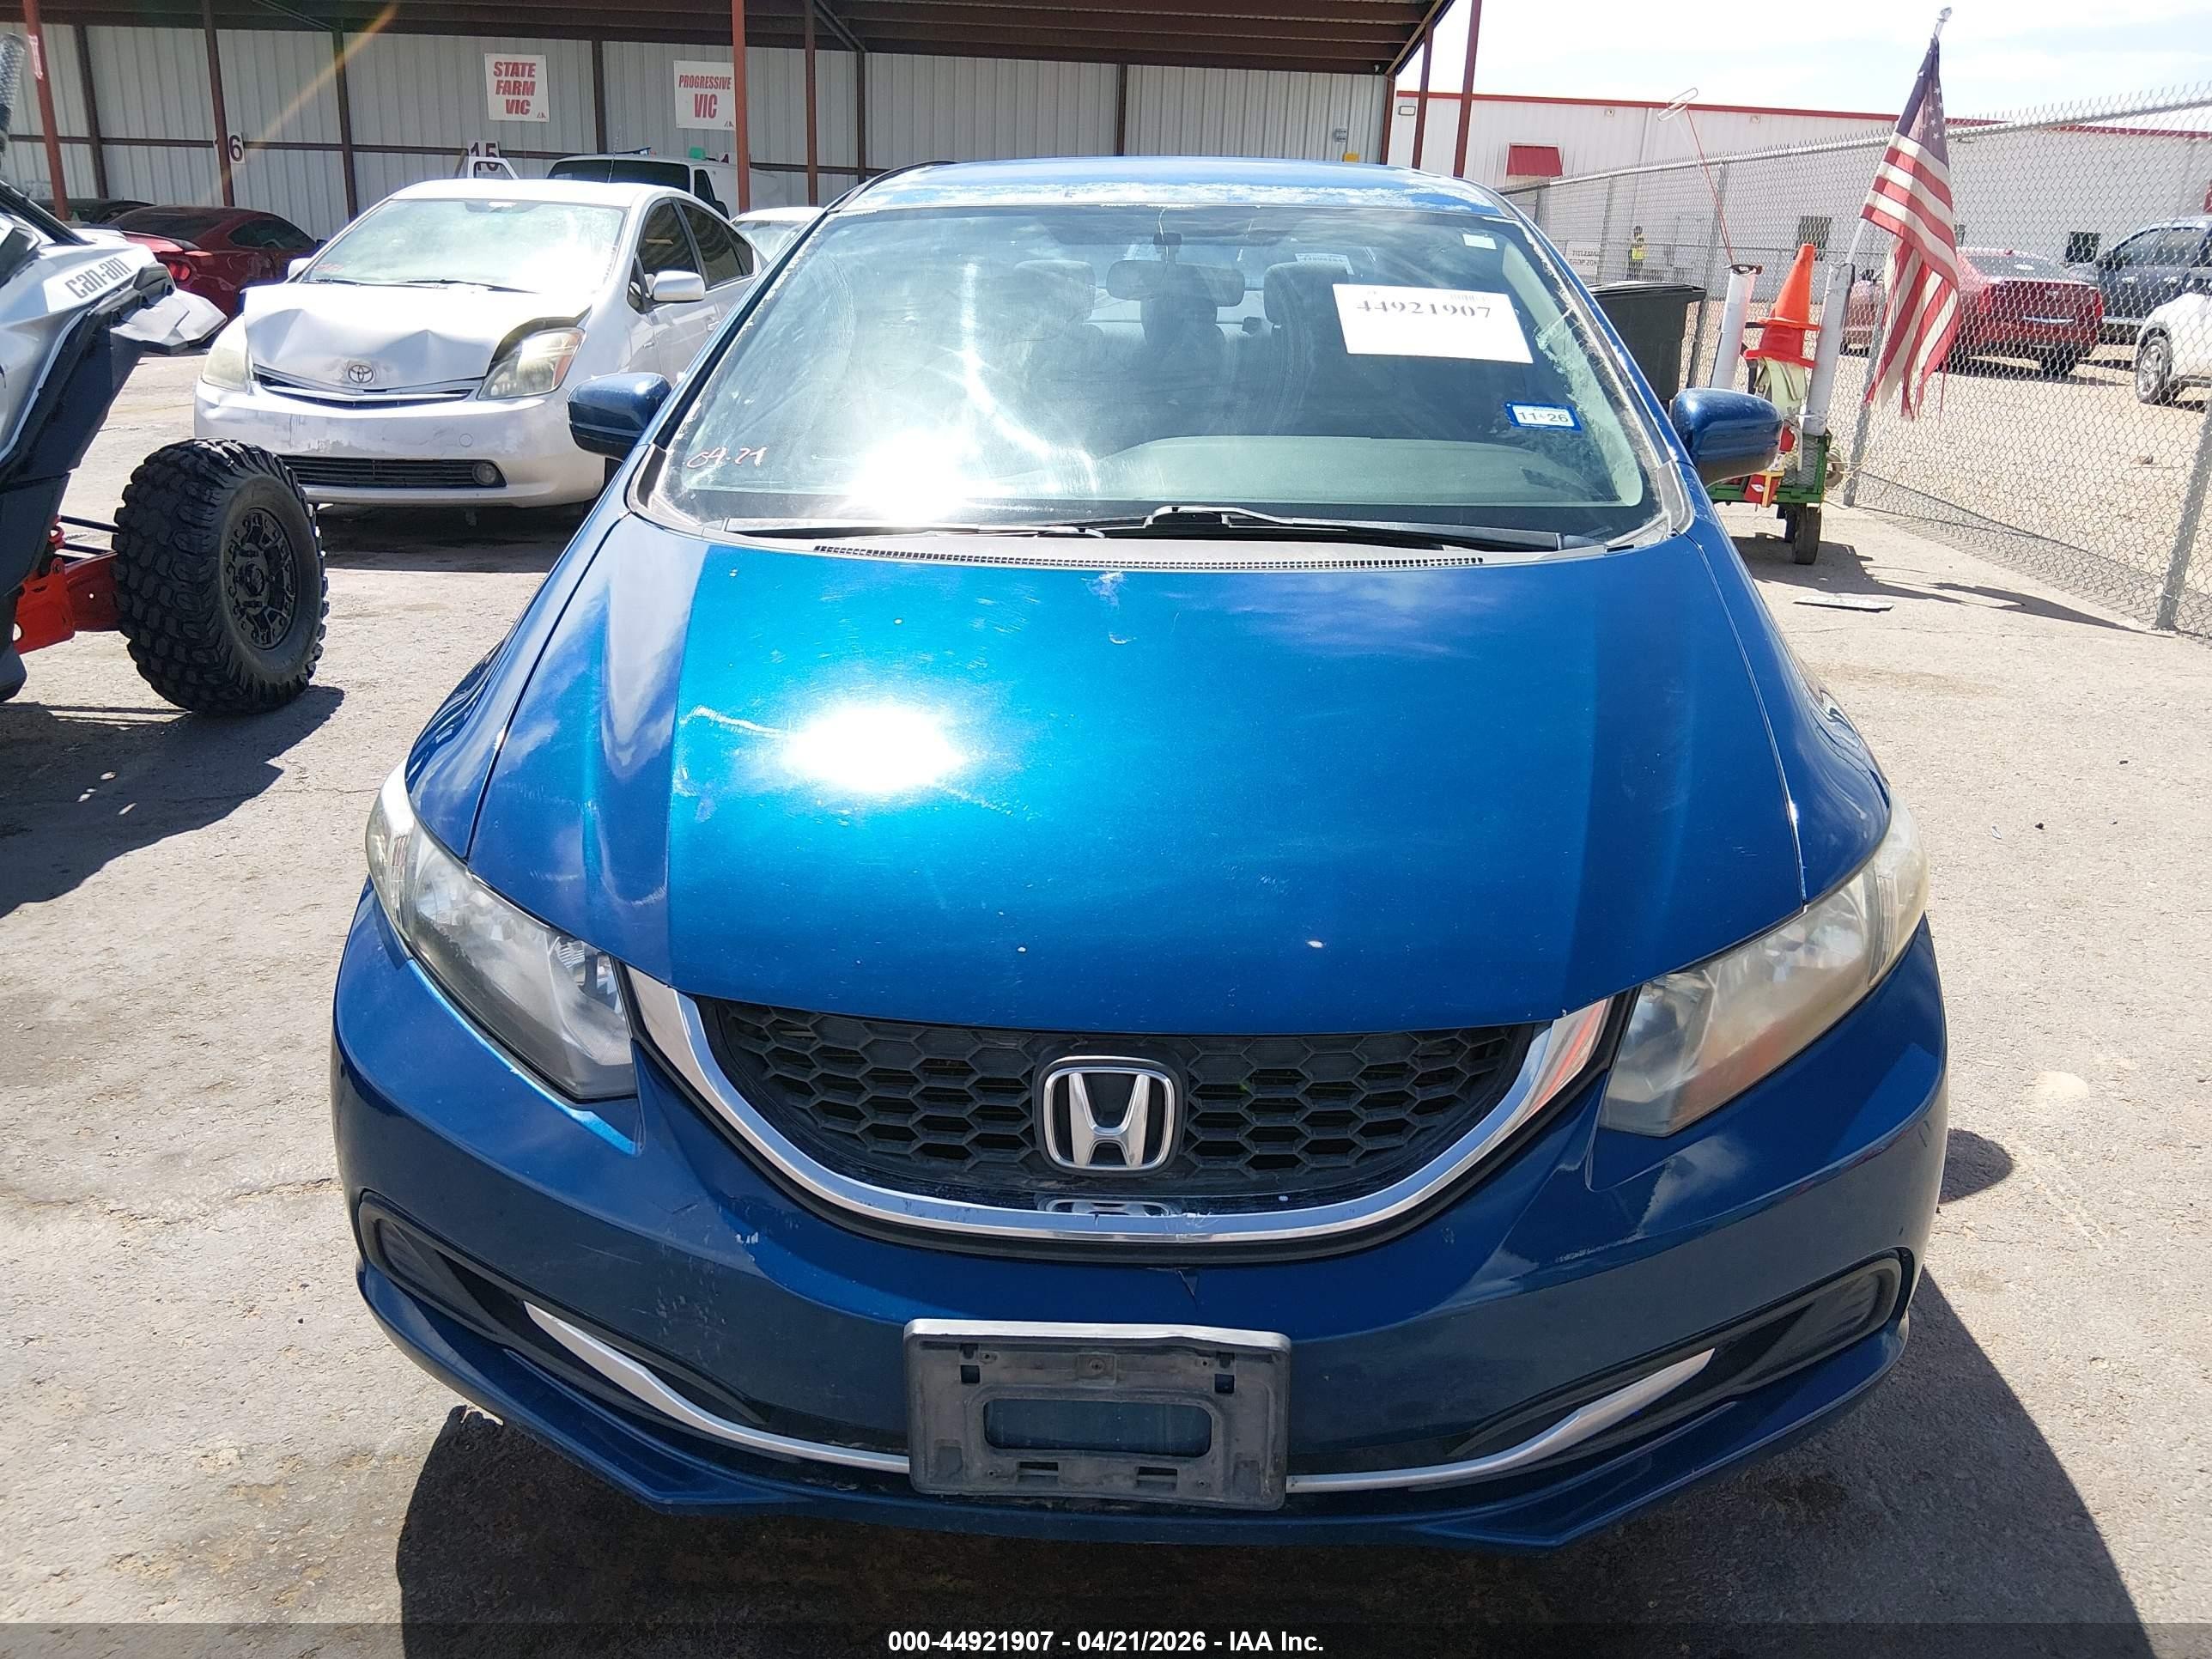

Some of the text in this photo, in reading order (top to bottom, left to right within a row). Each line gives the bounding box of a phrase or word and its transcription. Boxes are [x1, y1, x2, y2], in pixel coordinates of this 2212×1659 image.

[493, 61, 537, 78] STATE
[495, 79, 537, 96] FARM
[678, 74, 732, 90] PROGRESSIVE
[505, 99, 532, 115] VIC
[693, 93, 718, 119] VIC
[470, 142, 499, 172] 15
[1354, 300, 1492, 319] 44921907
